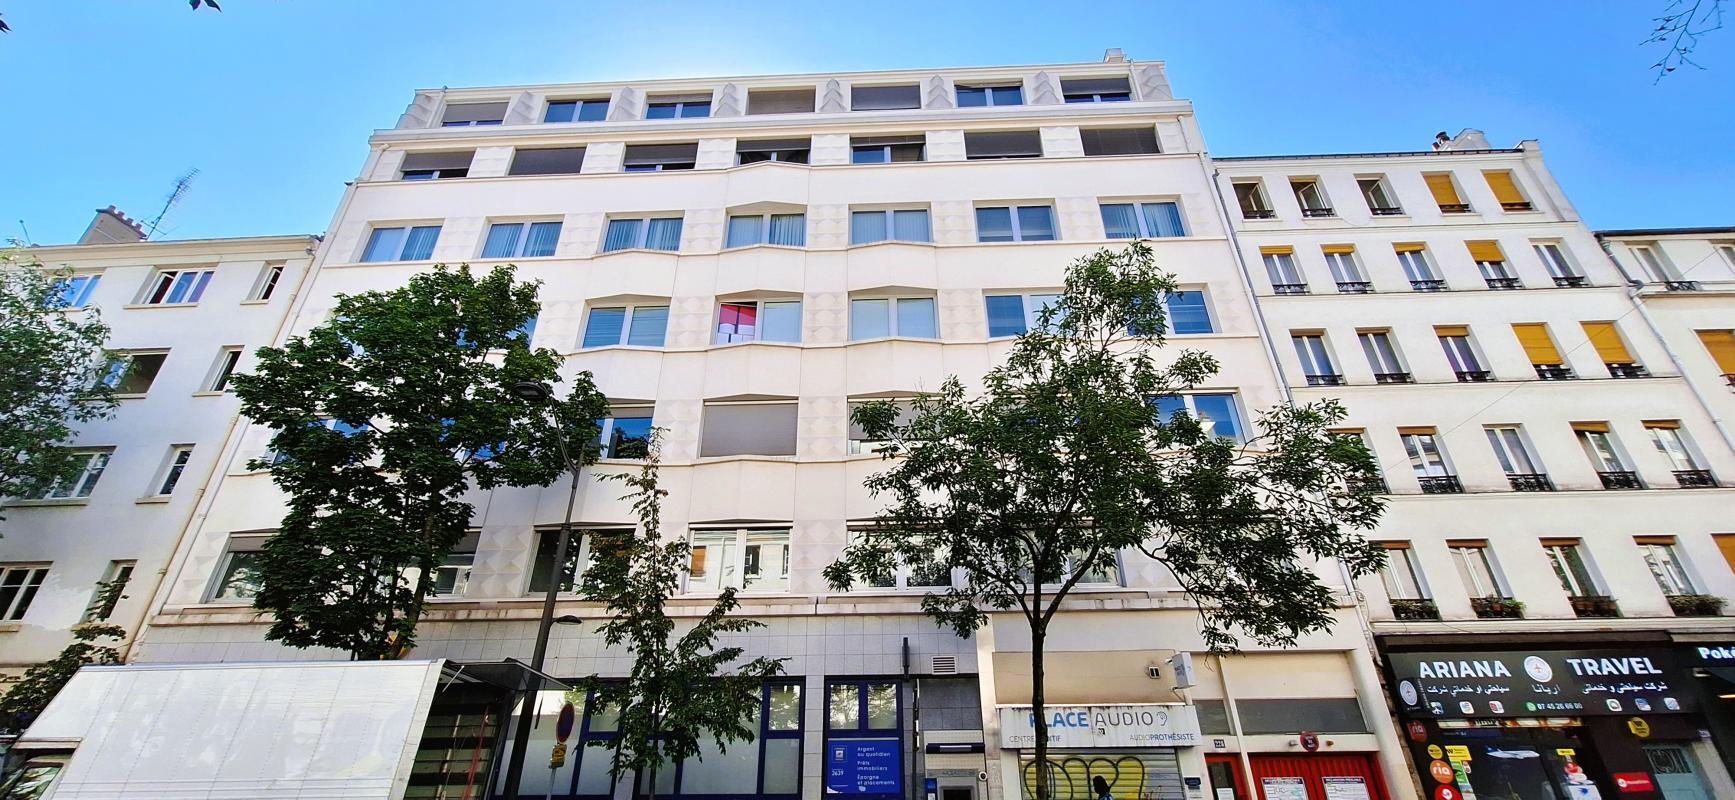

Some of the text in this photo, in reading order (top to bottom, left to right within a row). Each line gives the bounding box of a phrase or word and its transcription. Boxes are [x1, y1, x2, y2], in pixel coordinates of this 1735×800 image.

[1419, 657, 1662, 678] ARIANA TRAVEL
[1028, 712, 1153, 727] PACE AUDIO
[1433, 763, 1450, 775] ria
